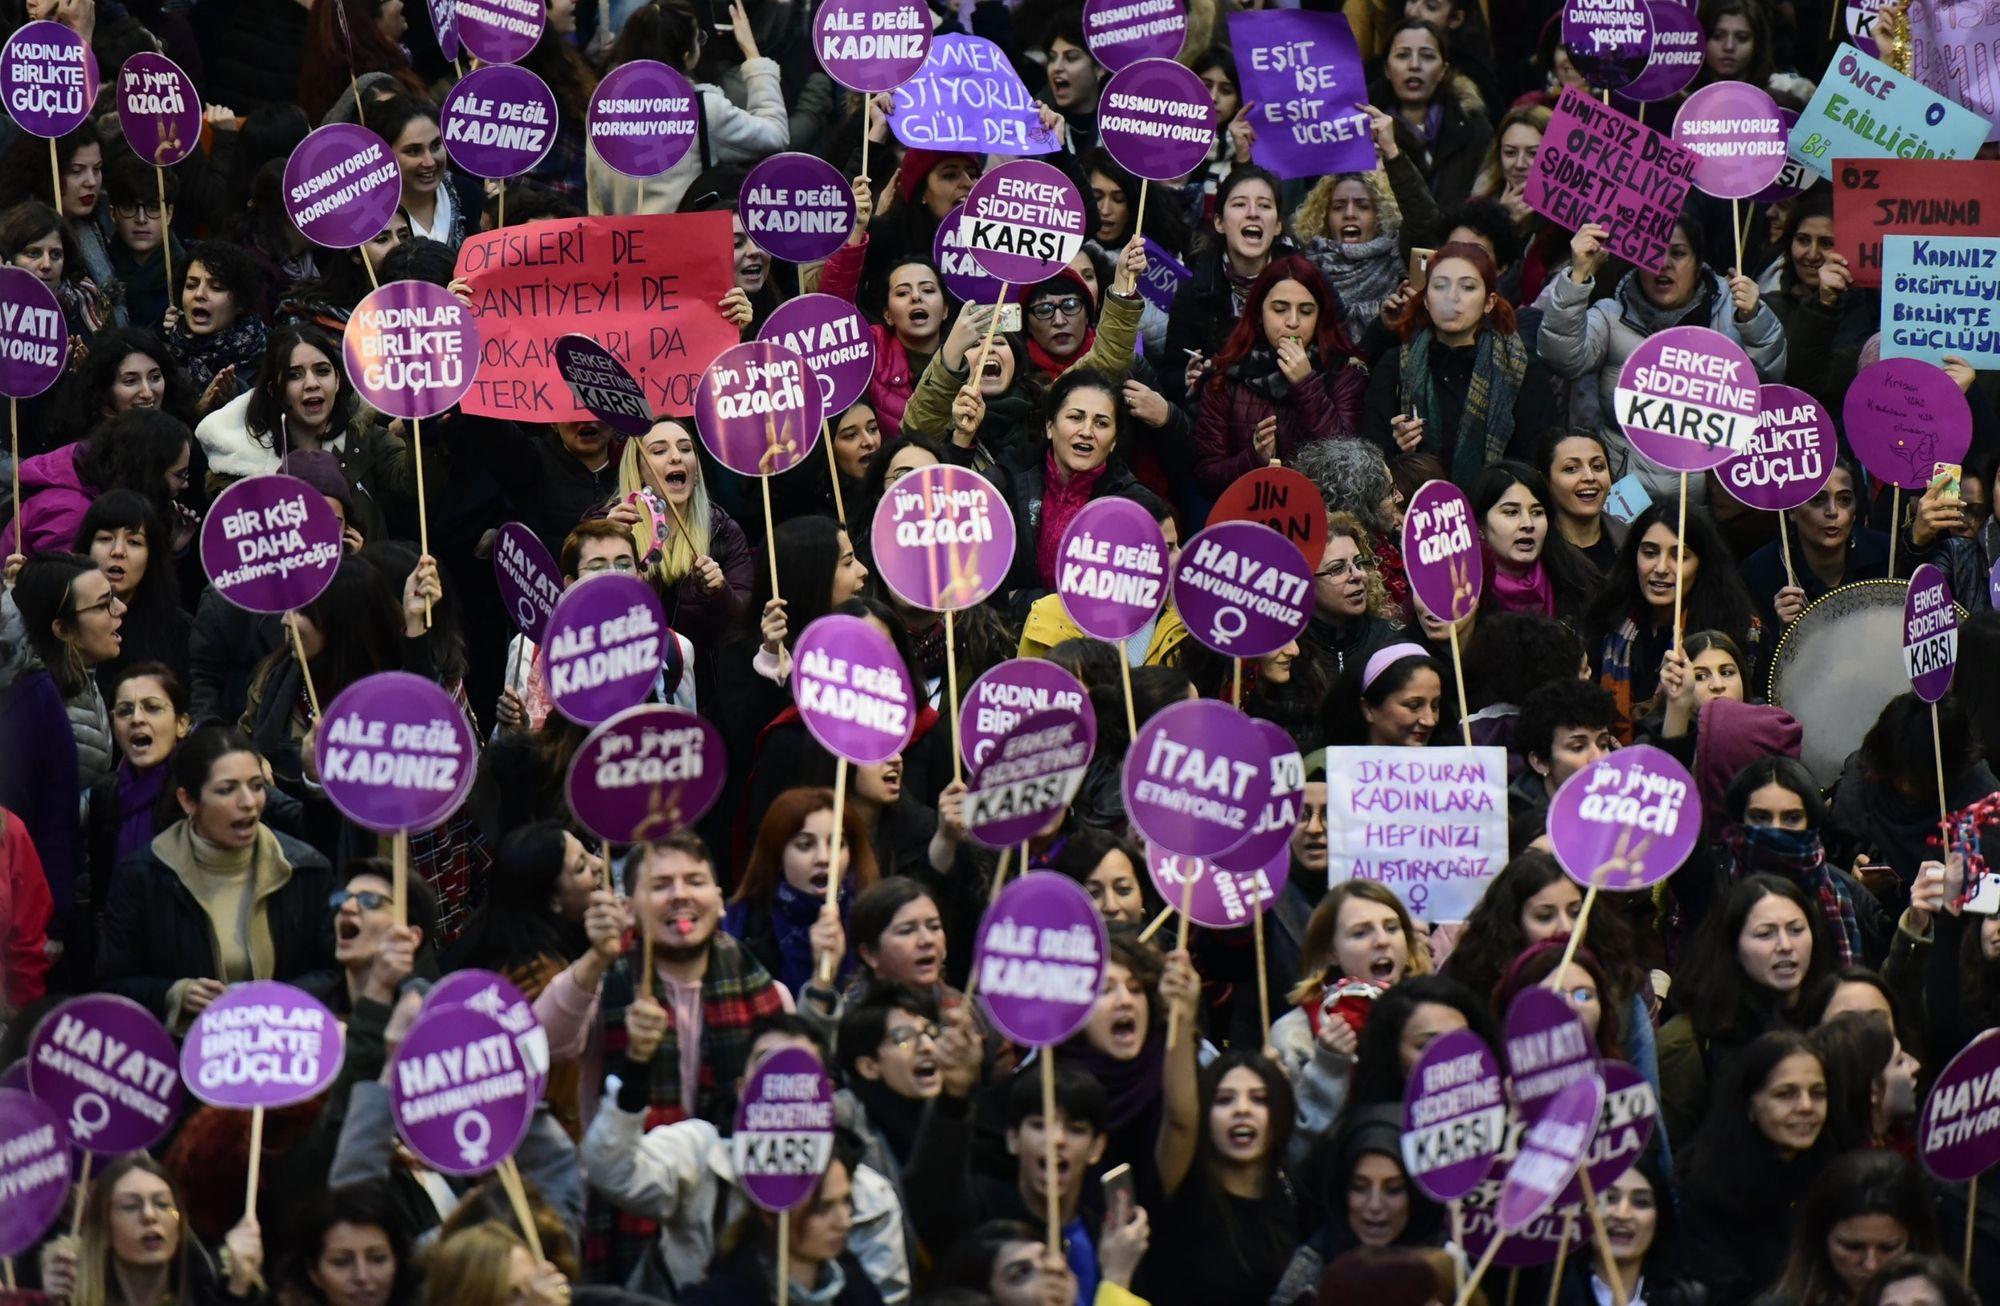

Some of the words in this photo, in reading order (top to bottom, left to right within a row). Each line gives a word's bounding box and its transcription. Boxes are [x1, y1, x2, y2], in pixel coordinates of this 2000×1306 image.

[455, 1, 540, 38] KORKMUYORUZ
[823, 12, 865, 30] AİLE
[872, 7, 924, 29] DEĞİL
[1089, 0, 1176, 28] SUSMUYORUZ
[1570, 9, 1644, 27] DAYANIŞMASI
[823, 35, 923, 60] KADINIZ
[1088, 15, 1184, 49] KORKMUYORUZ
[1588, 25, 1647, 52] yaşatır
[11, 43, 84, 62] KADINLAR
[1251, 41, 1315, 72] EŞİT
[12, 61, 83, 85] BİRLİKTE
[124, 68, 139, 92] jin
[142, 69, 178, 93] jiyan
[1295, 62, 1337, 94] İŞE
[1838, 49, 1897, 101] ÖNCE
[12, 86, 82, 117] GÜÇLÜ
[451, 93, 491, 117] AİLE
[498, 100, 548, 125] DEĞİL
[598, 98, 689, 113] SUSMUYORUZ
[1109, 93, 1209, 121] SUSMUYORUZ
[1264, 98, 1324, 123] EŞİT
[446, 118, 545, 152] KADINIZ
[592, 120, 694, 137] KORKMUYORUZ
[901, 110, 977, 142] GÜL
[984, 118, 1030, 151] DE!
[1101, 115, 1212, 145] KORKMUYORUZ
[1292, 114, 1369, 145] ÜCRET
[1682, 118, 1780, 134] SUSMUYORUZ
[1640, 130, 1698, 183] DEĞİL
[1683, 140, 1786, 157] ORKMUYORUZ
[291, 143, 382, 203] SUSMUYORUZ
[1842, 162, 1880, 190] ÖZ
[295, 162, 397, 227] KORKMUYORUZ
[747, 184, 788, 205] AİLE
[795, 185, 847, 207] DEĞİL
[997, 177, 1069, 206] ERKEK
[748, 210, 847, 233] KADINIZ
[977, 196, 1082, 230] ŞİDDETİNE
[1873, 198, 1980, 226] SAVUNMA
[465, 223, 584, 272] OFİSLERİ
[612, 230, 646, 265] DE
[971, 221, 1066, 266] KARŞI
[1913, 240, 1997, 268] KADINIZ
[642, 276, 680, 311] DE
[1895, 272, 2000, 301] ÖRGÜTLÜY
[0, 301, 58, 340] YATI
[359, 304, 461, 332] KADINLAR
[1893, 302, 1991, 327] BİRLİKTE
[361, 329, 462, 357] BİRLİKTE
[650, 327, 687, 360] DA
[363, 357, 462, 396] GÜÇLÜ
[566, 364, 639, 393] ŞİDDETİNE
[568, 350, 619, 373] ERKEK
[712, 366, 740, 395] jin
[745, 359, 798, 388] jiyan
[1659, 346, 1742, 382] ERKEK
[473, 380, 554, 411] TERK
[576, 385, 647, 419] KARŞI
[1634, 366, 1756, 411] ŞİDDETİNE
[1627, 395, 1736, 451] KARŞI
[1731, 451, 1822, 489] GÜÇLÜ
[223, 509, 261, 539] BİR
[266, 494, 308, 529] KİŞİ
[892, 487, 924, 521] jin
[929, 484, 988, 518] jiyan
[1413, 505, 1430, 540] jin
[1431, 498, 1465, 529] jiyan
[238, 528, 305, 562] DAHA
[1066, 531, 1110, 562] AİLE
[1113, 541, 1163, 574] DEĞİL
[215, 543, 338, 590] eksilmeyeceğiz
[497, 550, 552, 617] SAVUNUYOR
[503, 531, 559, 604] HAYAT
[1193, 539, 1309, 606] HAYATI
[1061, 563, 1160, 609] KADINIZ
[1180, 566, 1302, 626] SAVUNUYORUZ
[1914, 583, 1945, 614] ERKEK
[549, 624, 596, 661] AİLE
[603, 604, 659, 649] DEĞİL
[1908, 604, 1954, 645] ŞİDDETİNE
[551, 640, 661, 699] KADINIZ
[801, 647, 847, 684] AİLE
[851, 663, 907, 702] DEĞİL
[1910, 637, 1953, 677] KARŞI
[800, 676, 907, 737] KADINIZ
[979, 681, 1082, 715] KADINLAR
[328, 712, 386, 746] AİLE
[392, 719, 461, 754] DEĞİL
[323, 746, 459, 792] KADINIZ
[1146, 728, 1258, 800] İTAAT
[1585, 762, 1621, 793] jin
[1621, 764, 1686, 801] jiyan
[1352, 787, 1493, 813] KADINLARA
[985, 918, 1038, 957] AİLE
[980, 957, 1097, 1003] KADINIZ
[52, 1013, 176, 1097] HAYATI
[200, 1050, 319, 1087] GÜÇLÜ
[400, 1033, 514, 1096] HAYATI
[1930, 1065, 2000, 1122] HAYA
[1925, 1105, 2000, 1154] İSTİYOR
